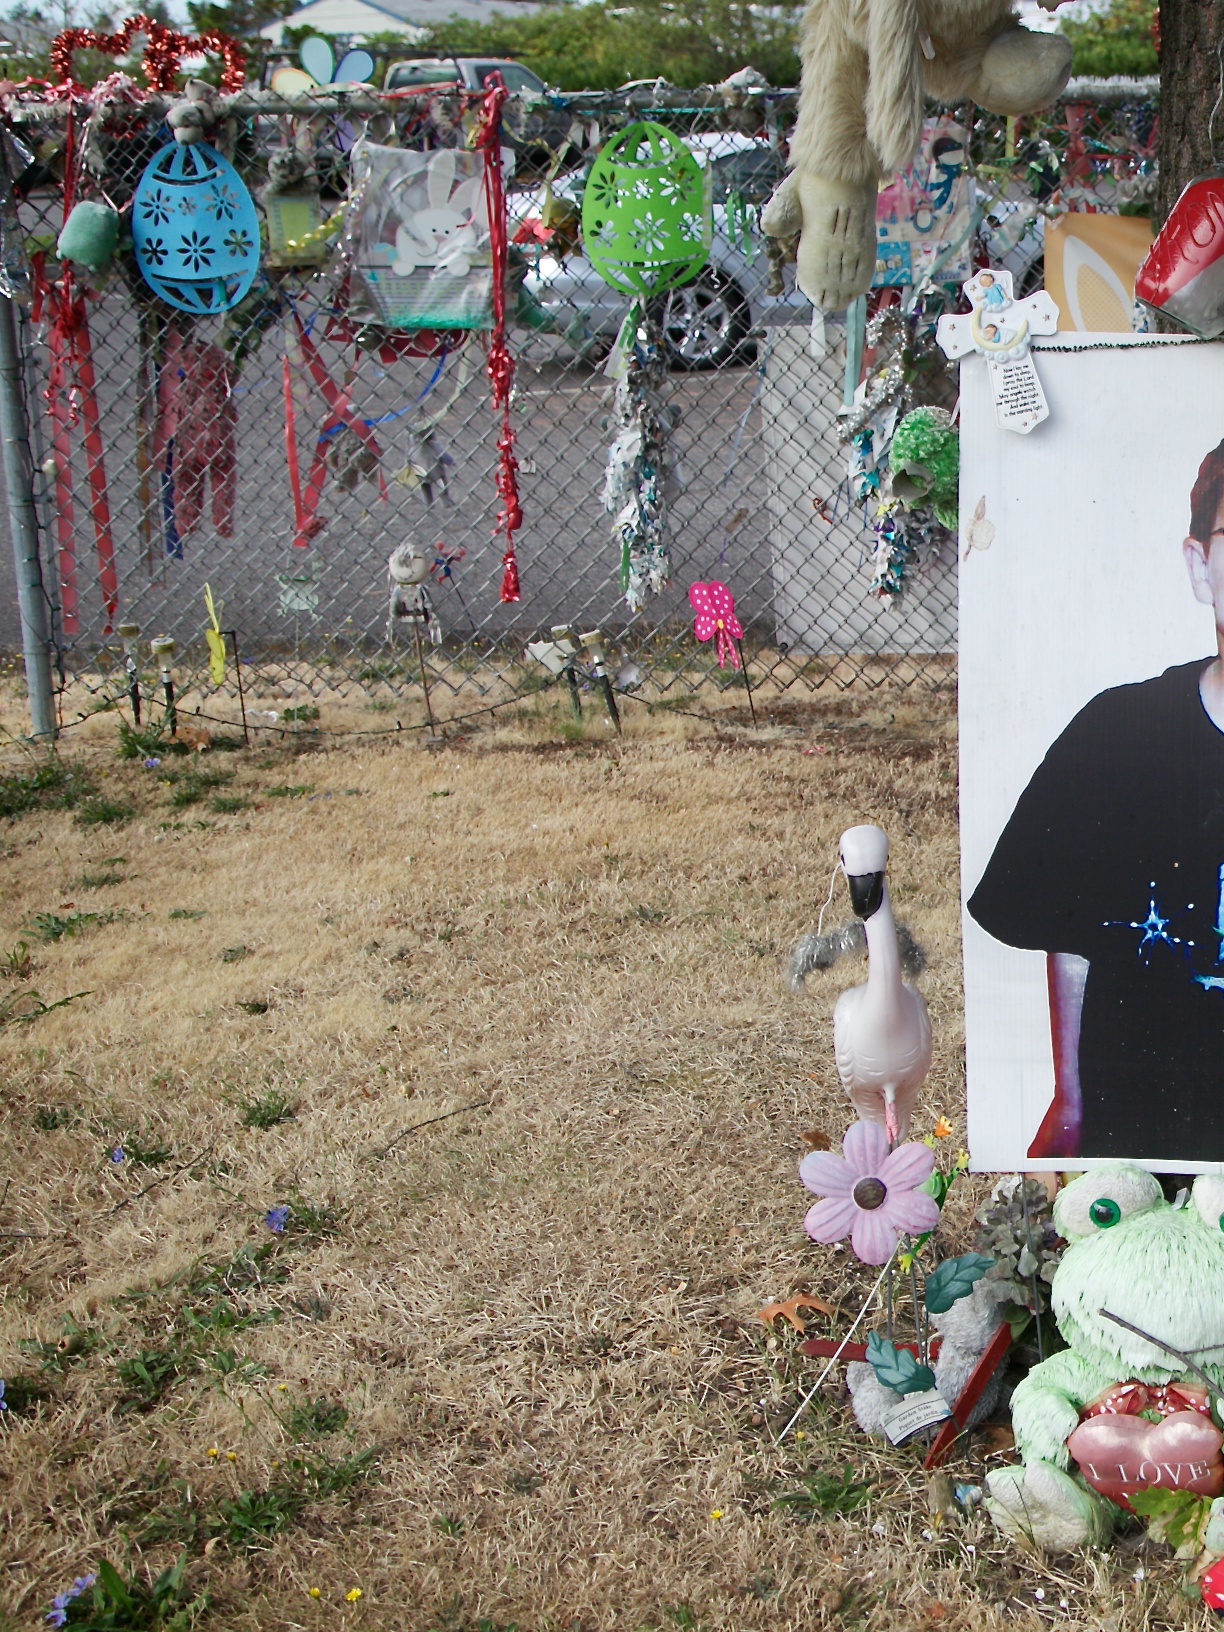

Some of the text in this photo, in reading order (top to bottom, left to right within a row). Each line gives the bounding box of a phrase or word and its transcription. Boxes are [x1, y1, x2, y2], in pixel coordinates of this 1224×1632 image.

[898, 1404, 931, 1422] Garden Stake
[923, 1409, 939, 1419] jardin
[1088, 1460, 1211, 1485] I LOVE
